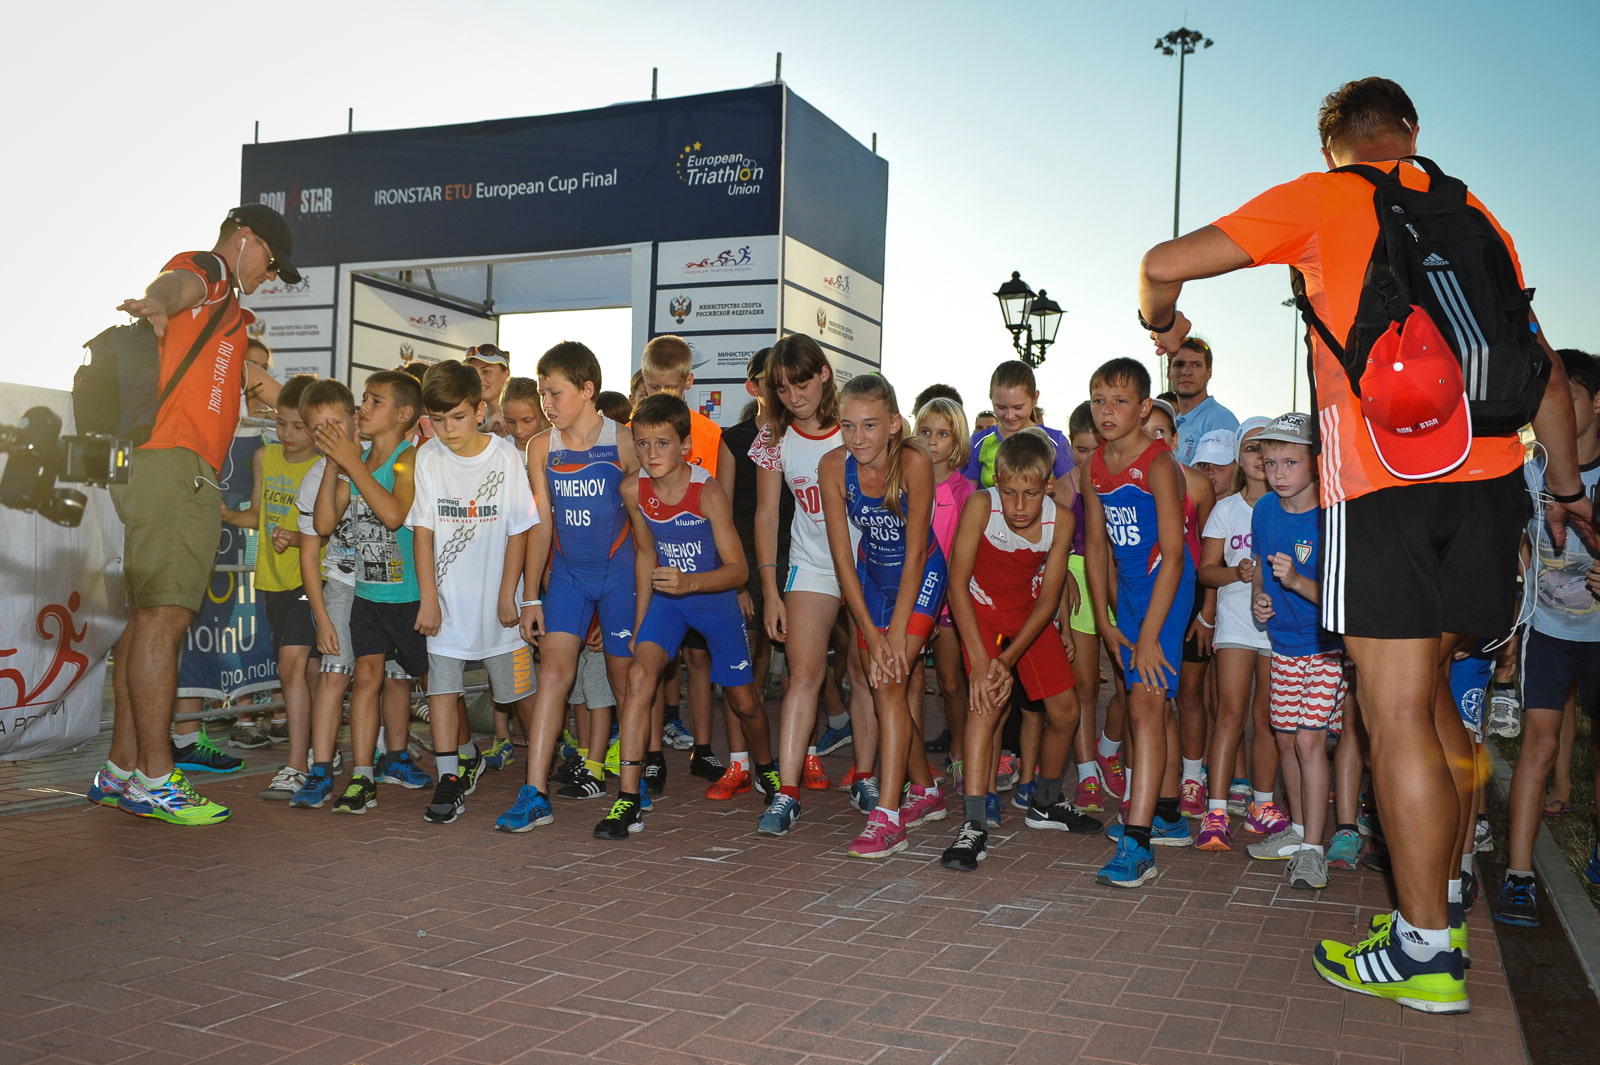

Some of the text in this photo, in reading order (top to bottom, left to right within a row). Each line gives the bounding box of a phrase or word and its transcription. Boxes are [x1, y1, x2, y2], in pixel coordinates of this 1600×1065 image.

[687, 153, 743, 167] European
[686, 165, 764, 186] Triathlon
[374, 168, 617, 206] IRONSTAR ETU European Cup Final
[728, 183, 760, 196] Union
[300, 187, 333, 213] STAR
[207, 340, 234, 414] IRON-STAR.RU
[554, 478, 606, 497] PIMENOV
[565, 509, 591, 527] RUS
[870, 526, 900, 541] RUS
[1106, 522, 1141, 547] RUS
